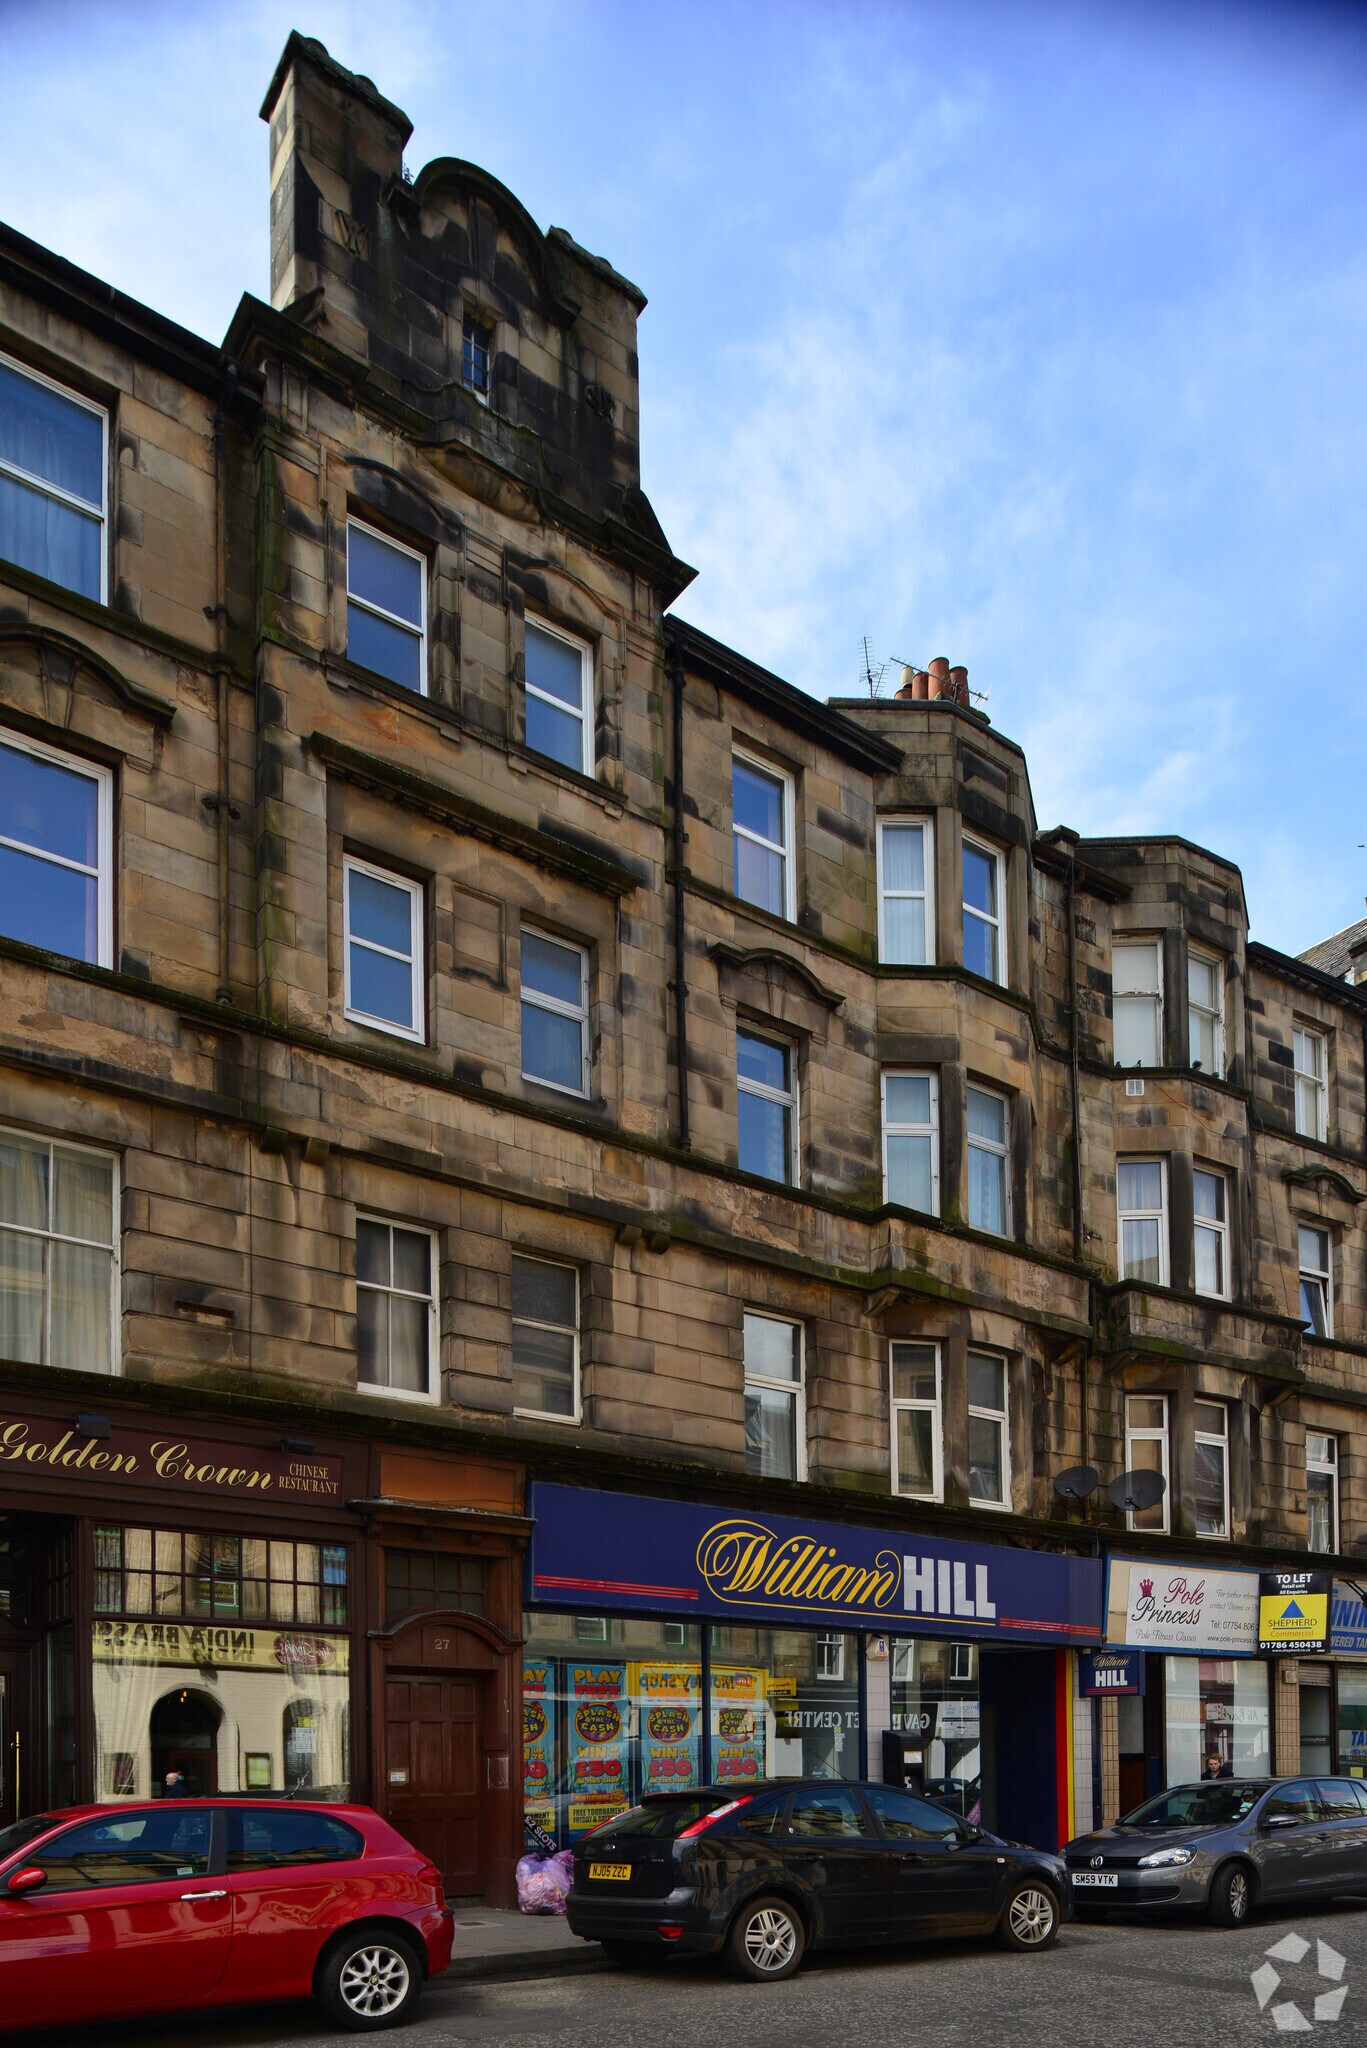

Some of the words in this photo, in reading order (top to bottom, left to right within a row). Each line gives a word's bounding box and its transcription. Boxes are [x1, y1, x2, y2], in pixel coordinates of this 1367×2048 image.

[0, 1421, 139, 1475] Golden
[149, 1440, 274, 1490] Crown
[288, 1462, 329, 1480] CHINESE
[278, 1475, 339, 1495] RESTAURANT
[696, 1518, 901, 1608] William
[903, 1555, 996, 1619] HILL
[1276, 1574, 1291, 1584] TO
[1293, 1573, 1313, 1583] LET
[1163, 1577, 1206, 1605] Pole
[1131, 1595, 1202, 1625] Princess
[1222, 1620, 1242, 1631] 07754
[1243, 1622, 1255, 1632] 806
[1268, 1618, 1318, 1628] SHEPHERD
[1270, 1630, 1314, 1638] Commercial
[434, 1639, 450, 1650] 27
[1288, 1641, 1322, 1649] 450438
[1093, 1654, 1131, 1669] William
[523, 1668, 547, 1683] AY
[574, 1669, 622, 1684] PLAY
[1095, 1669, 1128, 1687] HILL
[574, 1684, 621, 1699] FREE
[576, 1708, 620, 1722] SPLASH
[649, 1710, 690, 1723] SPLASH
[581, 1722, 614, 1732] CASH
[653, 1723, 684, 1733] CASH
[721, 1724, 752, 1734] CASH
[576, 1746, 607, 1758] WIN
[650, 1747, 678, 1759] WIN
[718, 1747, 744, 1759] WIN
[575, 1759, 622, 1777] £50
[649, 1759, 692, 1777] £50
[717, 1759, 757, 1776] £50
[573, 1809, 586, 1817] FREE
[587, 1807, 626, 1816] TOURNAMENT
[573, 1816, 592, 1824] FRIDAY
[534, 1826, 557, 1851] SLOTS
[592, 1865, 610, 1877] NJ05
[611, 1866, 628, 1878] ZZC
[1075, 1874, 1096, 1885] SM59
[1098, 1875, 1115, 1885] VTK
